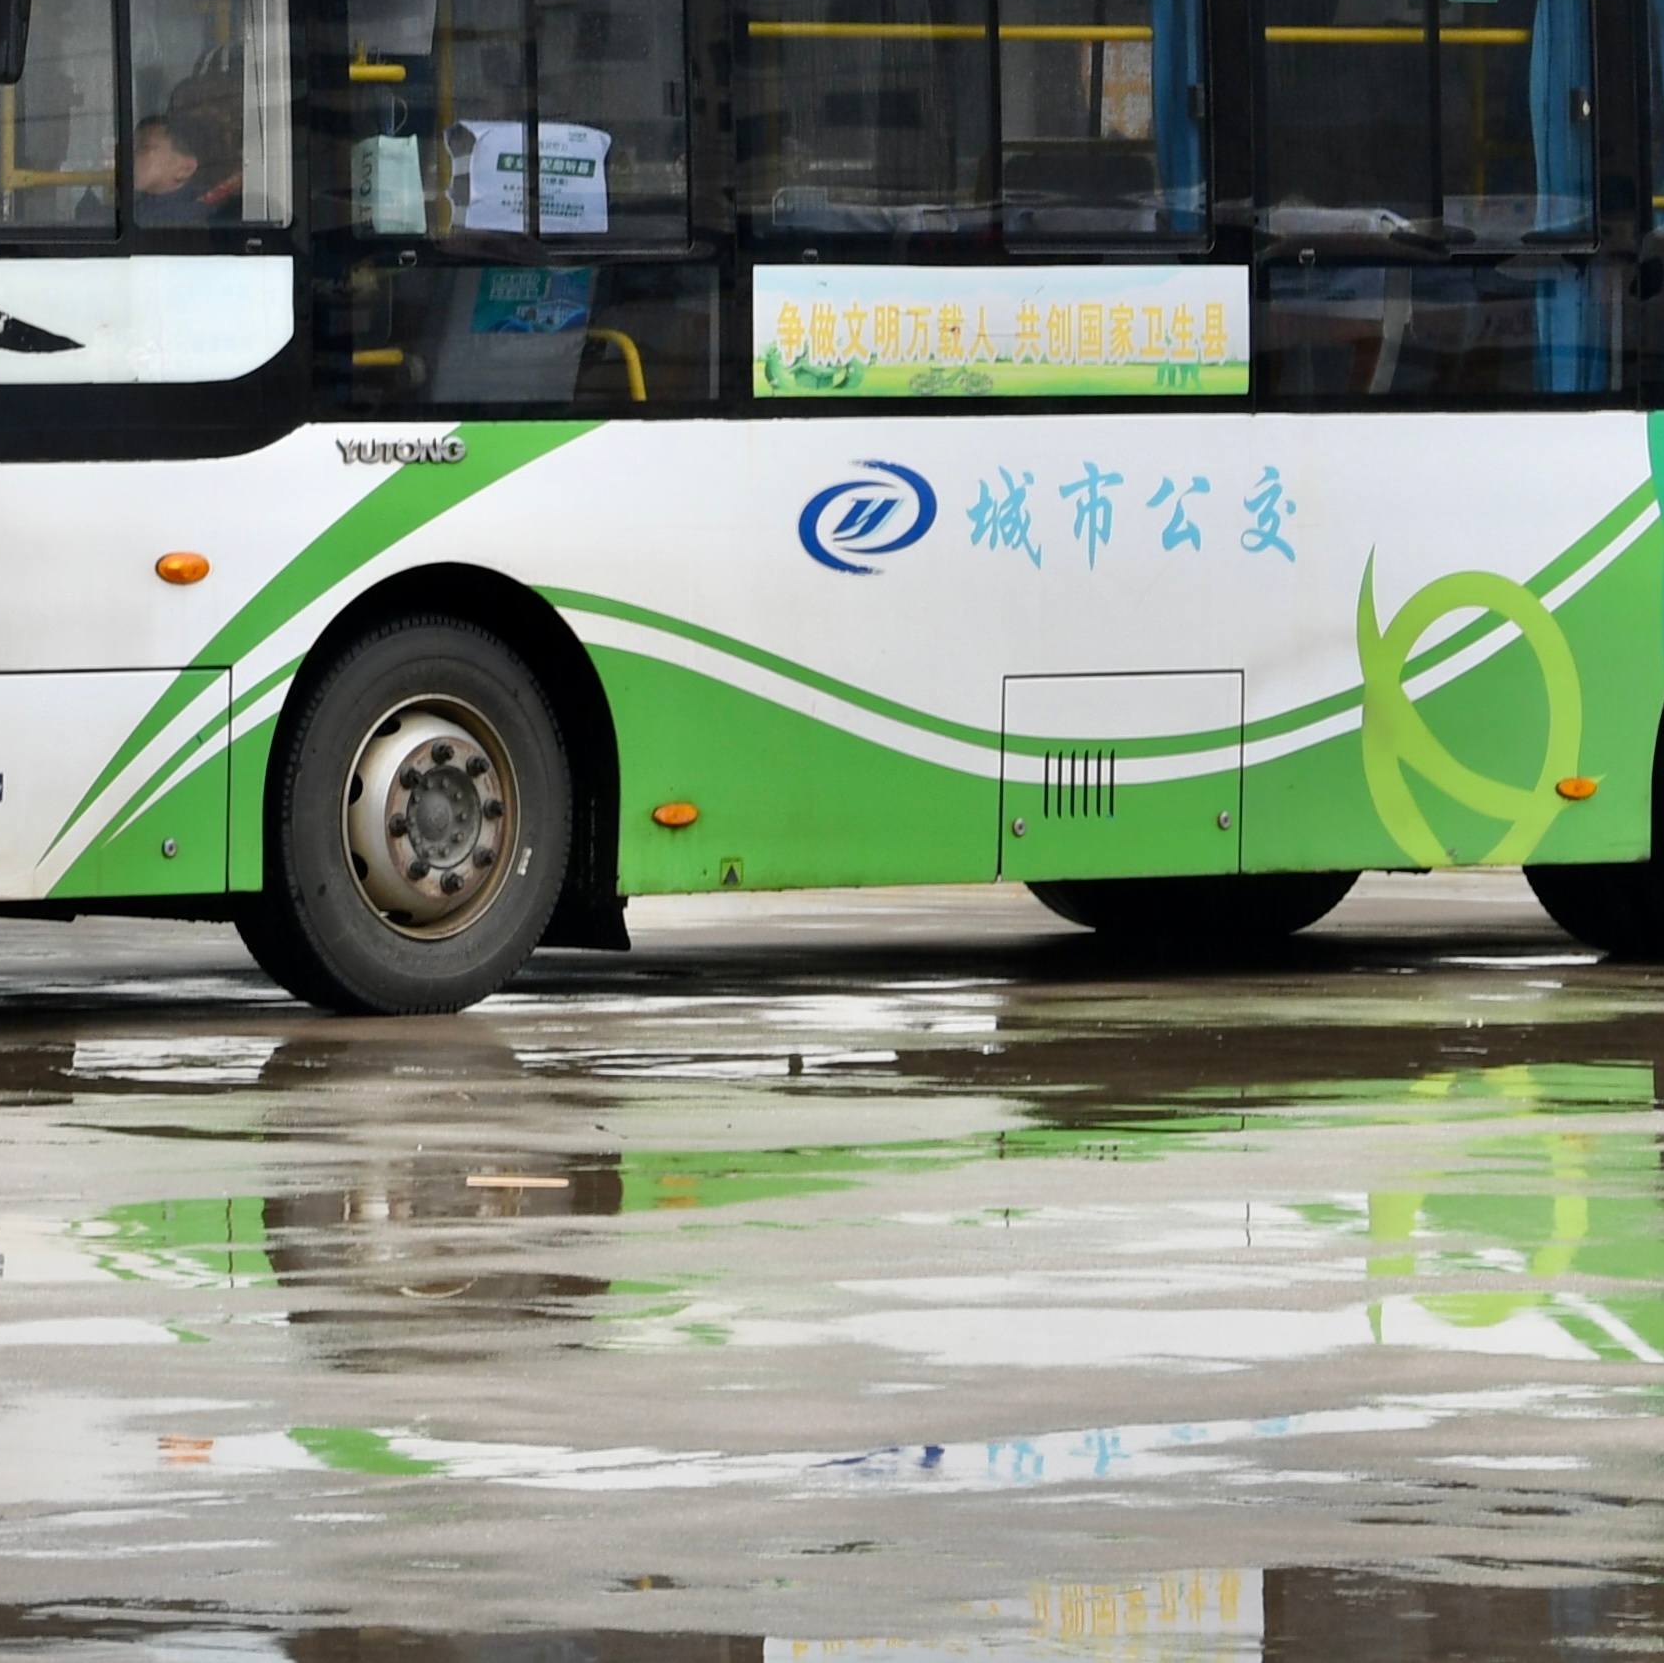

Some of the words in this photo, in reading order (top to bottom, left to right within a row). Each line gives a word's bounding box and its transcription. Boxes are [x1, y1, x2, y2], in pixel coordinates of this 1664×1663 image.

[776, 300, 997, 364] 争做文明万载人
[1014, 302, 1229, 364] 共创国家卫生县
[337, 436, 467, 464] YUTONG
[965, 461, 1298, 572] 城市公交
